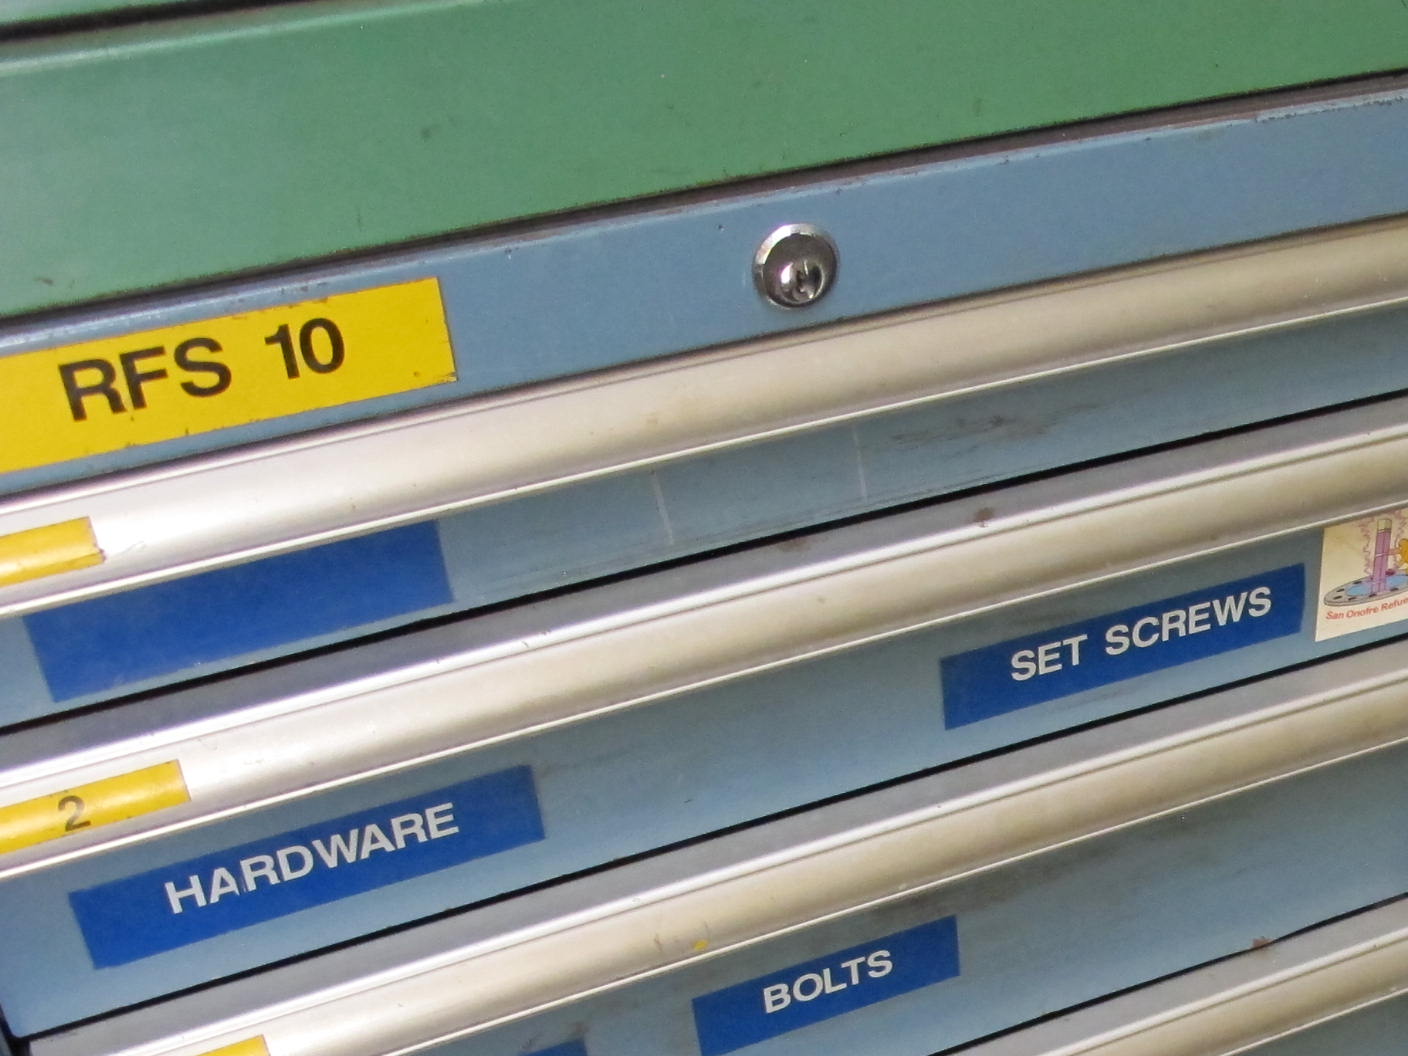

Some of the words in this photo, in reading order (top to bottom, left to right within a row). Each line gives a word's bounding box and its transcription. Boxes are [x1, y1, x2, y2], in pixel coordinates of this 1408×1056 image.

[58, 337, 232, 421] RFS
[265, 317, 346, 380] 10
[1011, 636, 1088, 684] SET
[1104, 584, 1274, 657] SCREWS
[1326, 610, 1345, 620] San
[57, 794, 92, 833] 2
[165, 803, 460, 914] HARDWARE
[762, 949, 894, 1016] BOLTS
